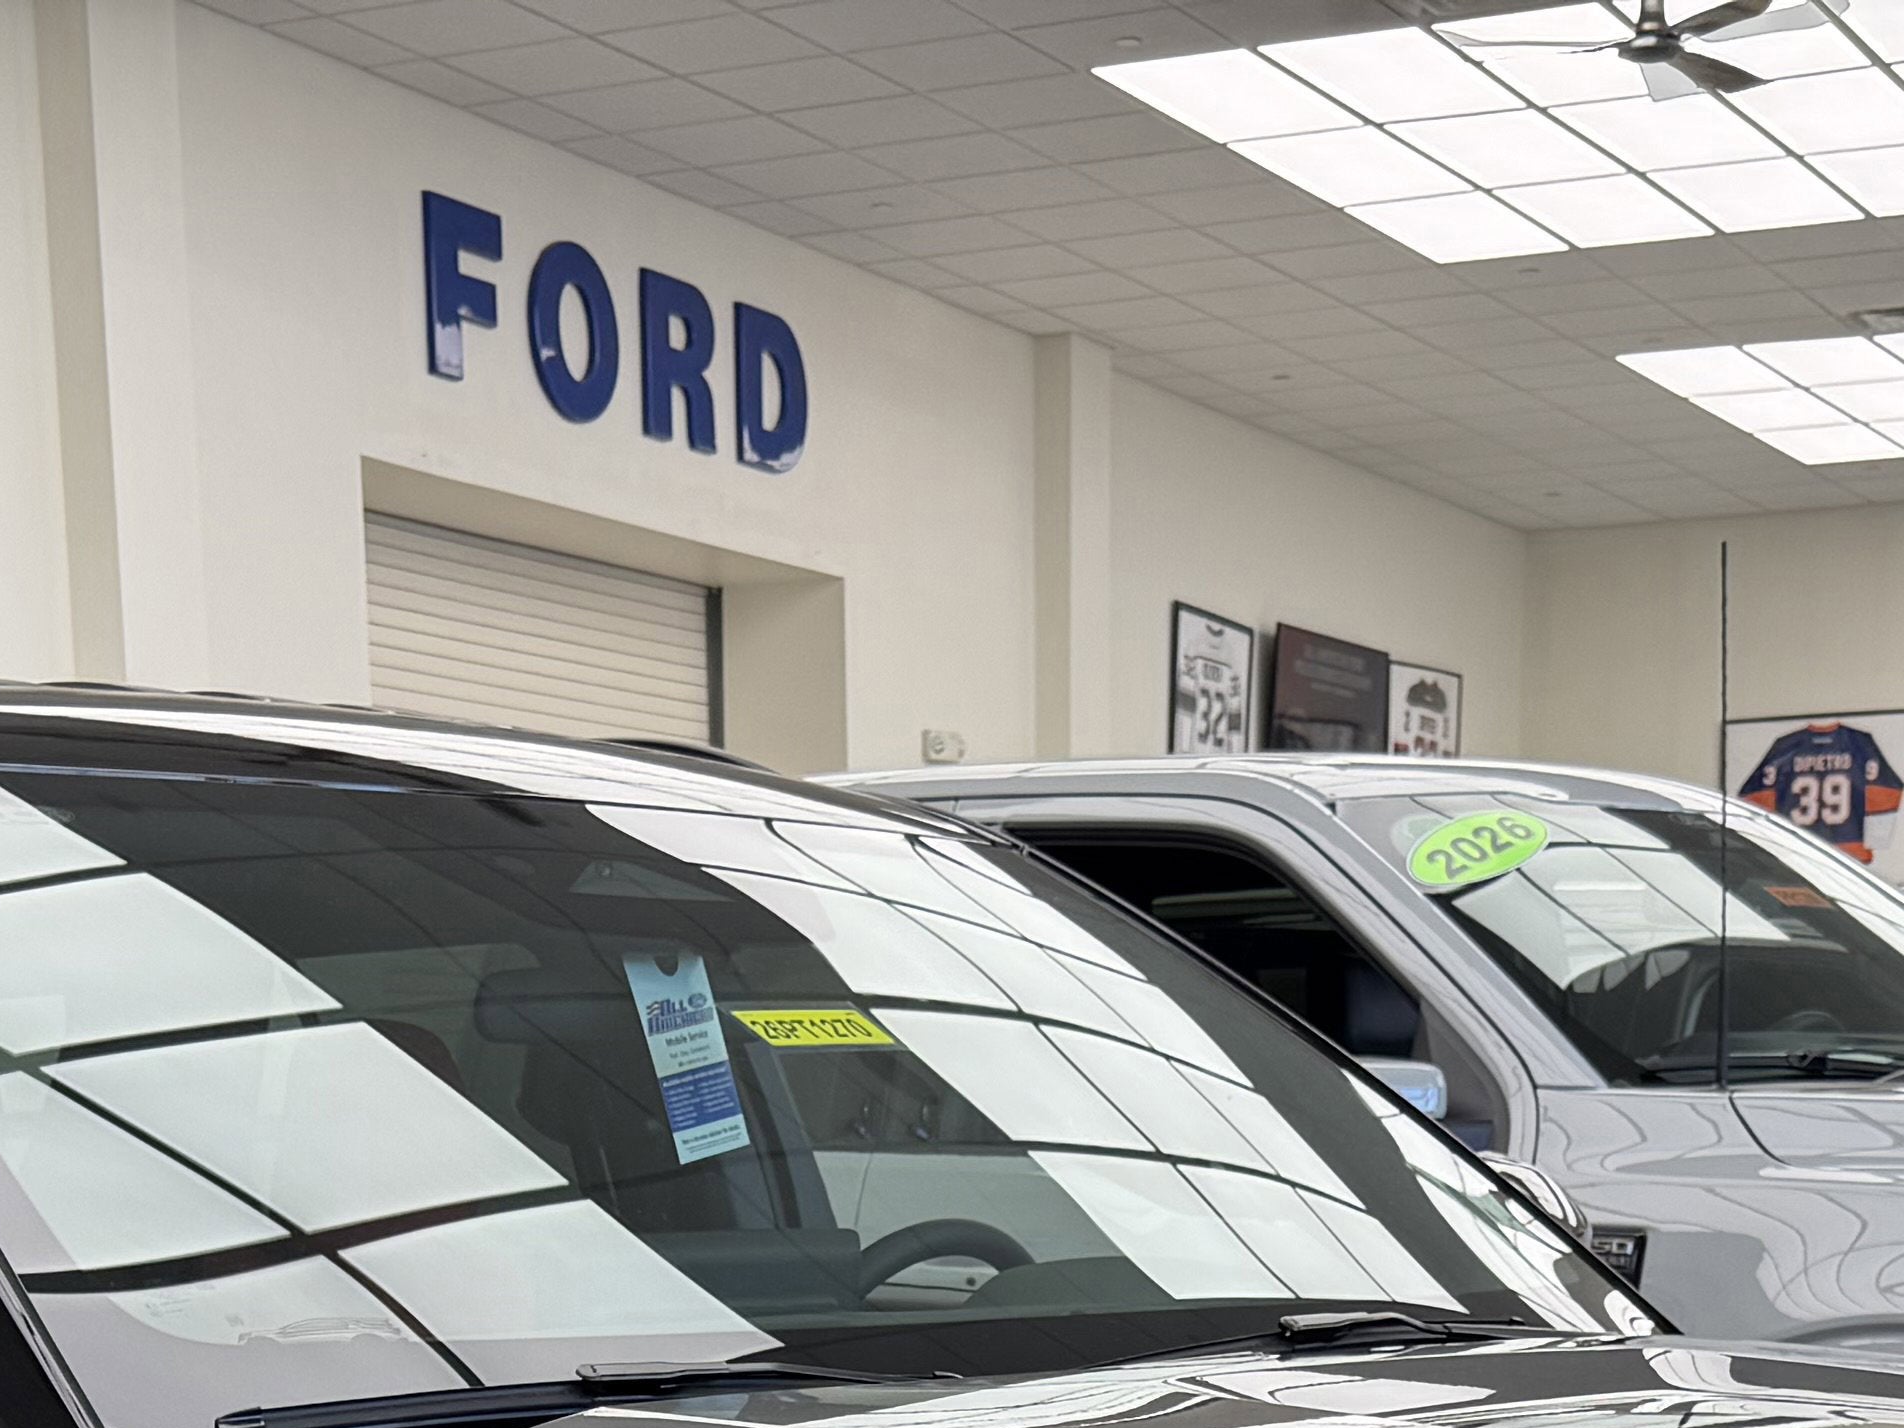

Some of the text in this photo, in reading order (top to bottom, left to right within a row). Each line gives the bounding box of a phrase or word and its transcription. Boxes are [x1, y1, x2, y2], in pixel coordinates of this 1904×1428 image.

[422, 190, 809, 475] FORD
[1790, 774, 1853, 826] 39
[1424, 816, 1535, 881] 2026
